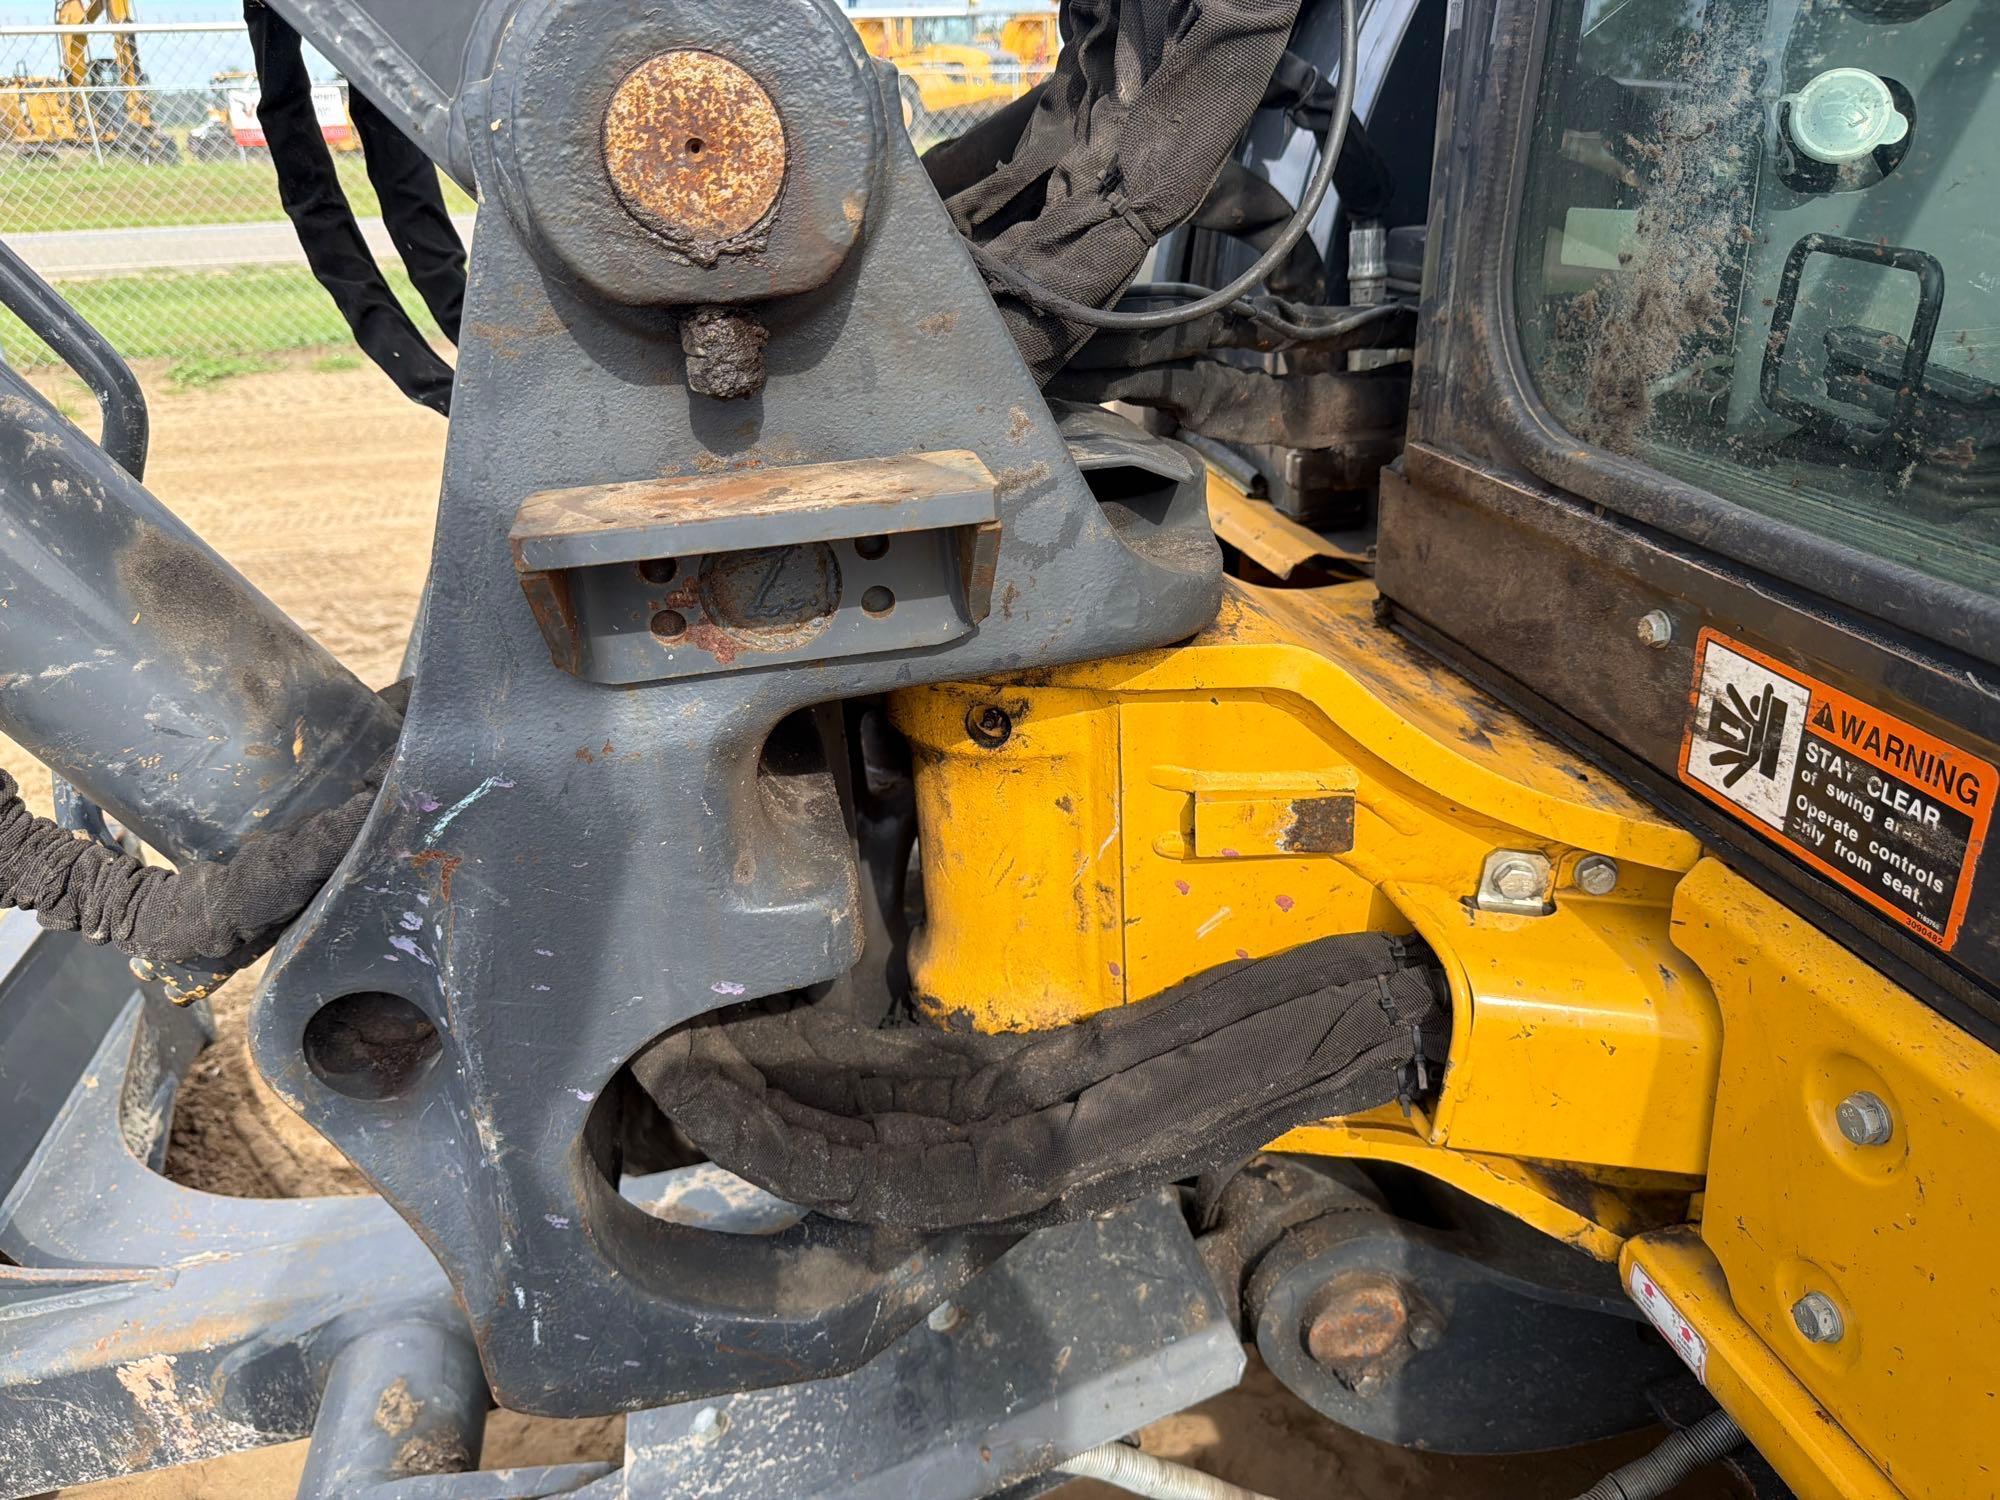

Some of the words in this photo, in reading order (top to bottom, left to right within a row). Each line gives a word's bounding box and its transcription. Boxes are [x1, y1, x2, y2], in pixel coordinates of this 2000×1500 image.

[1801, 770, 1818, 786] of
[1826, 783, 1875, 823] swing
[1805, 741, 1856, 783] STAY
[1867, 775, 1941, 831] CLEAR
[1841, 710, 1981, 807] WARNING
[1796, 794, 1858, 842] Operate
[1868, 841, 1944, 893] controls
[1834, 838, 1872, 874] from
[1881, 871, 1923, 906] seat.
[1905, 917, 1943, 946] 3090482
